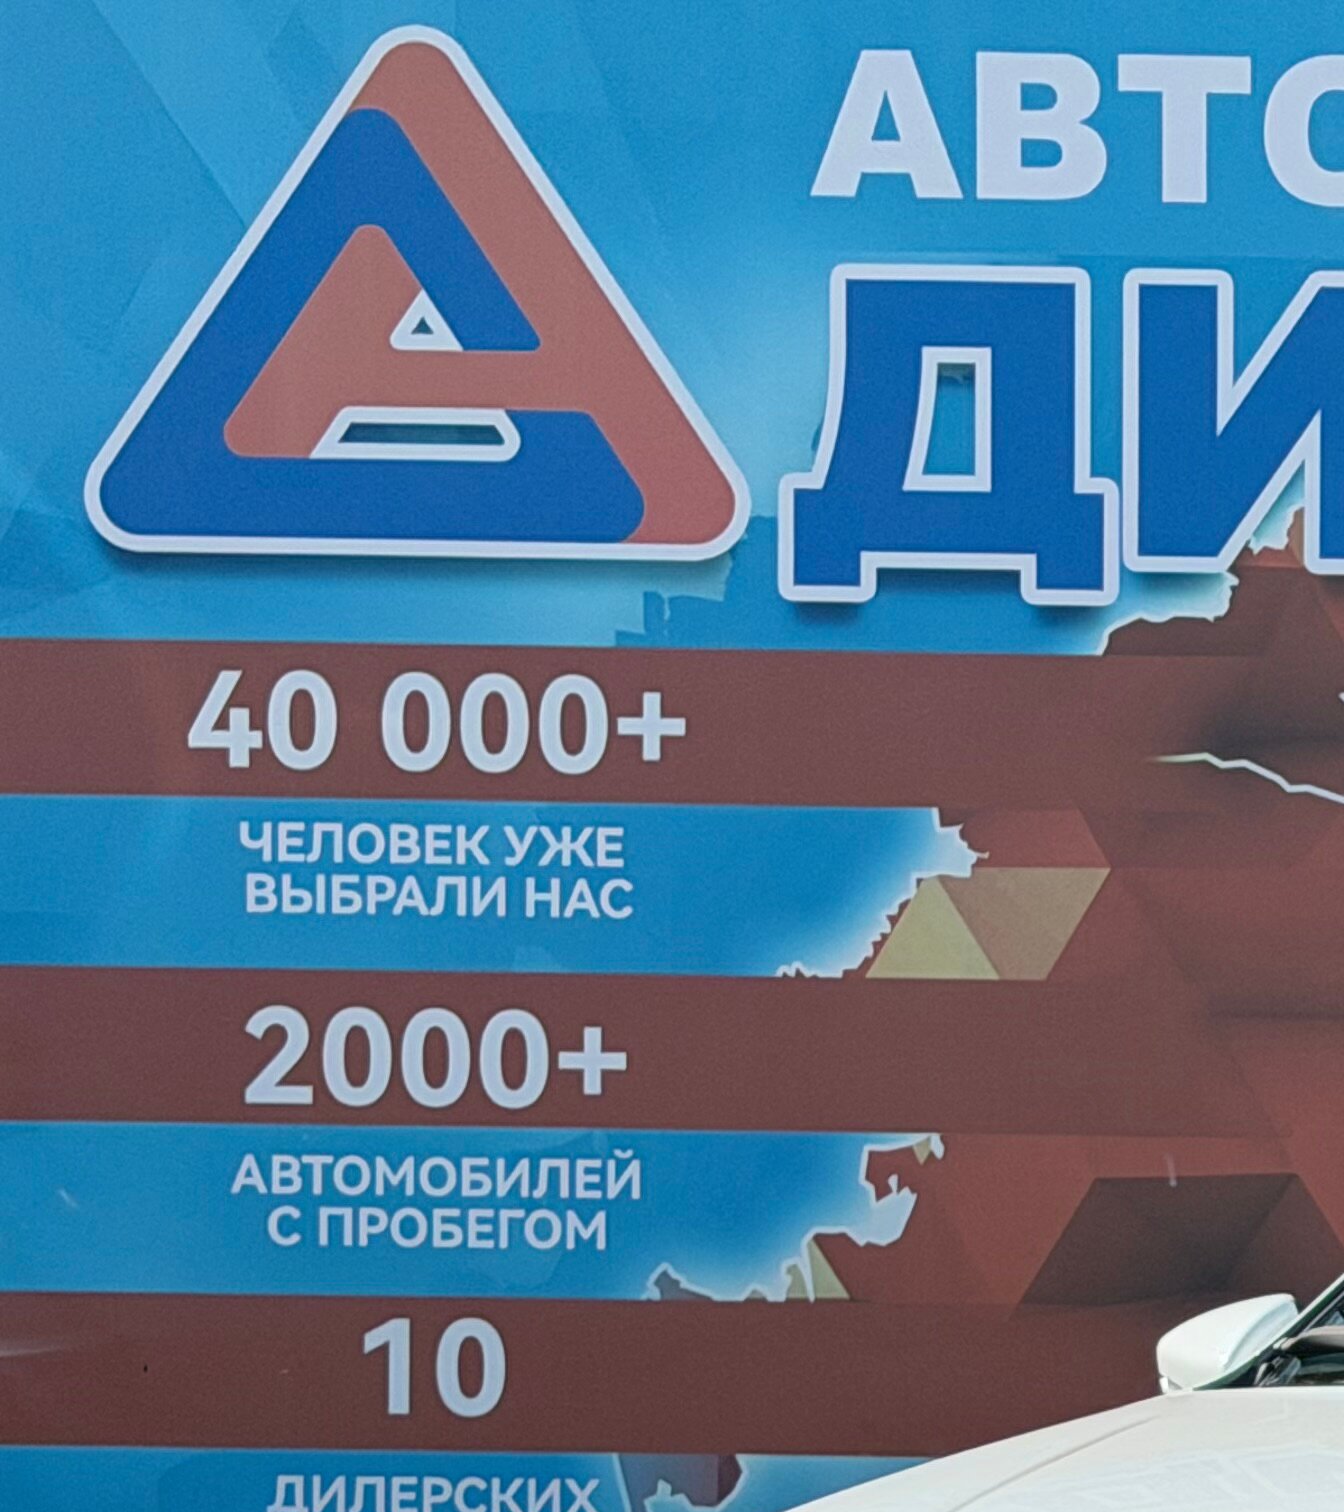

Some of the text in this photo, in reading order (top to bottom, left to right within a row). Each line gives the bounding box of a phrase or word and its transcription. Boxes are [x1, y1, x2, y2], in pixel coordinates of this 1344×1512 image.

[187, 669, 687, 775] 40 000+
[239, 821, 625, 869] ЧЕЛОВЕК УЖЕ
[244, 873, 635, 920] ВЫБРАЛИ НАС
[243, 1005, 628, 1111] 2000+
[231, 1149, 642, 1201] АВТОМОБИЛЕЙ
[267, 1206, 607, 1251] С ПРОБЕГОМ
[362, 1317, 506, 1418] 10
